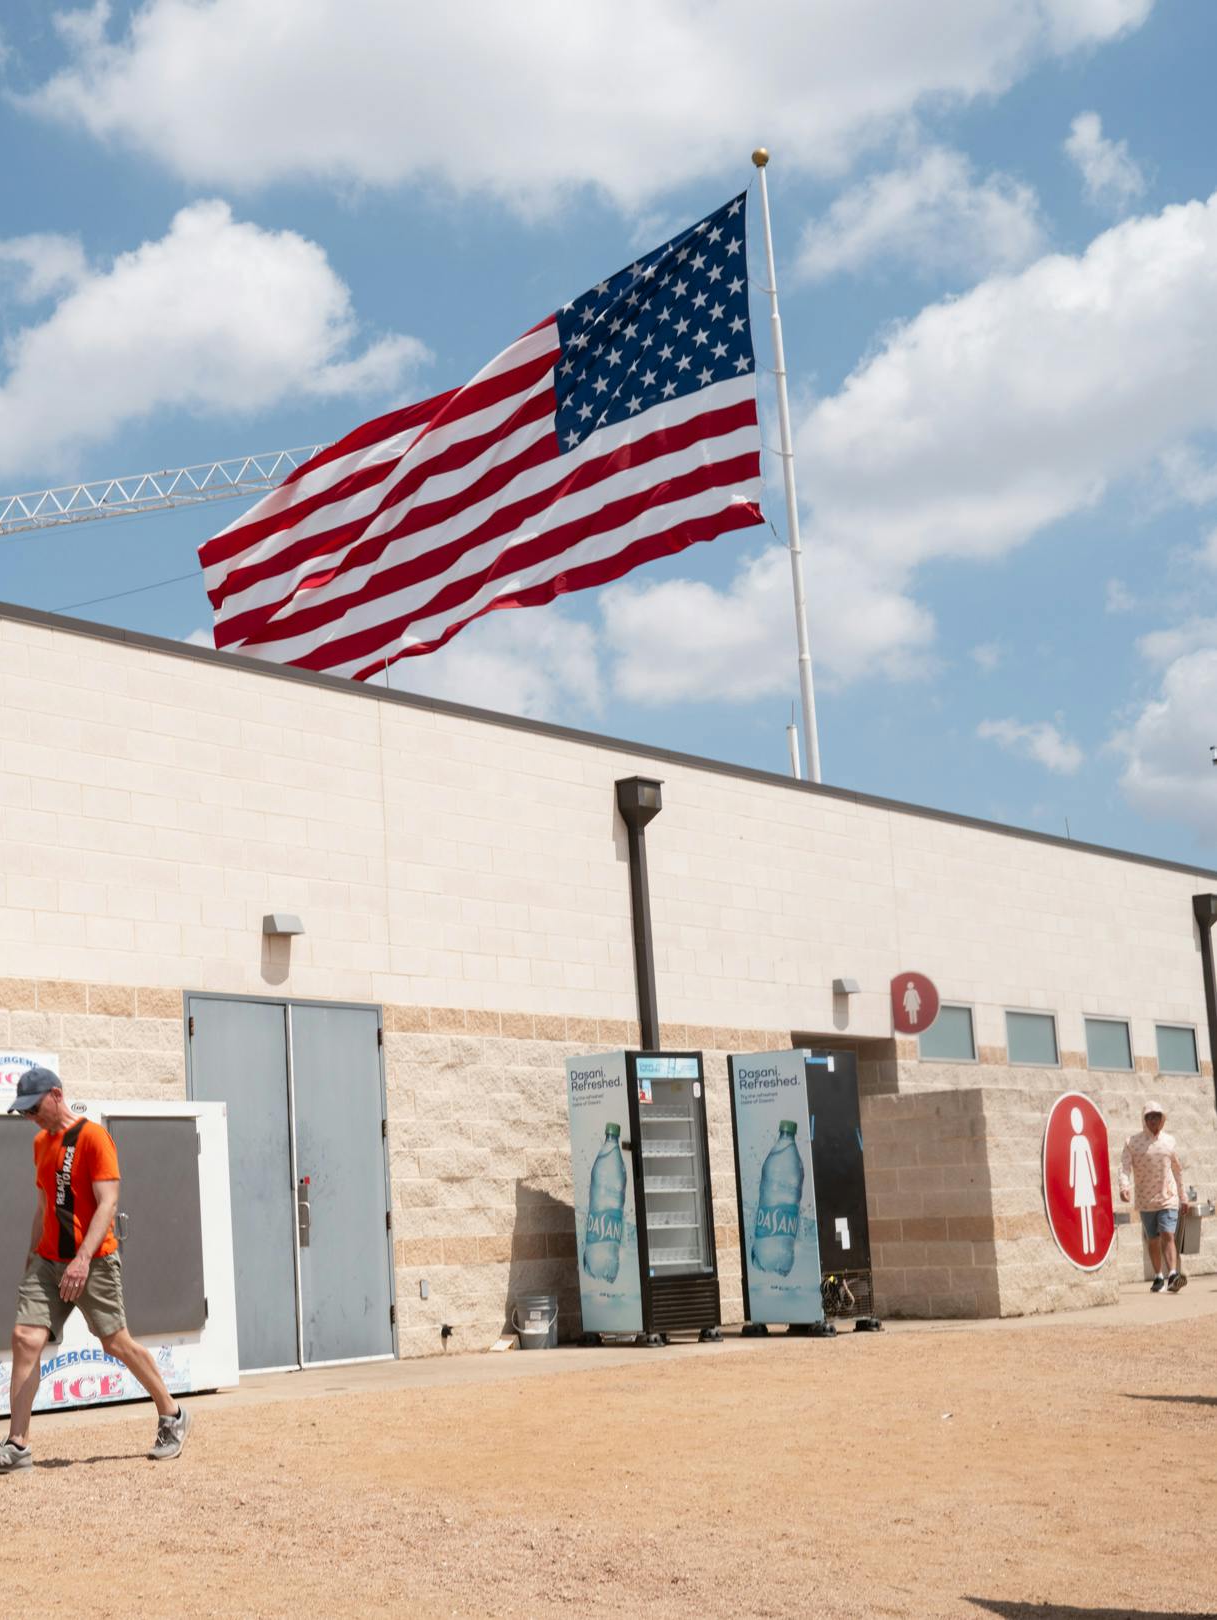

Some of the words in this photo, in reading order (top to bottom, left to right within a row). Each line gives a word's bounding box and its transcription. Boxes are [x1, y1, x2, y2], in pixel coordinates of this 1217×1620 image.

[570, 1066, 606, 1081] Dasani.
[571, 1075, 623, 1092] Refreshed.
[738, 1065, 781, 1080] Dasani.
[739, 1075, 800, 1090] Refreshed.
[63, 1145, 76, 1173] RACE
[55, 1172, 66, 1206] READY
[587, 1213, 622, 1241] DASANI
[757, 1208, 798, 1235] DASANI
[41, 1349, 127, 1377] MERGENC
[50, 1373, 125, 1405] ICE
